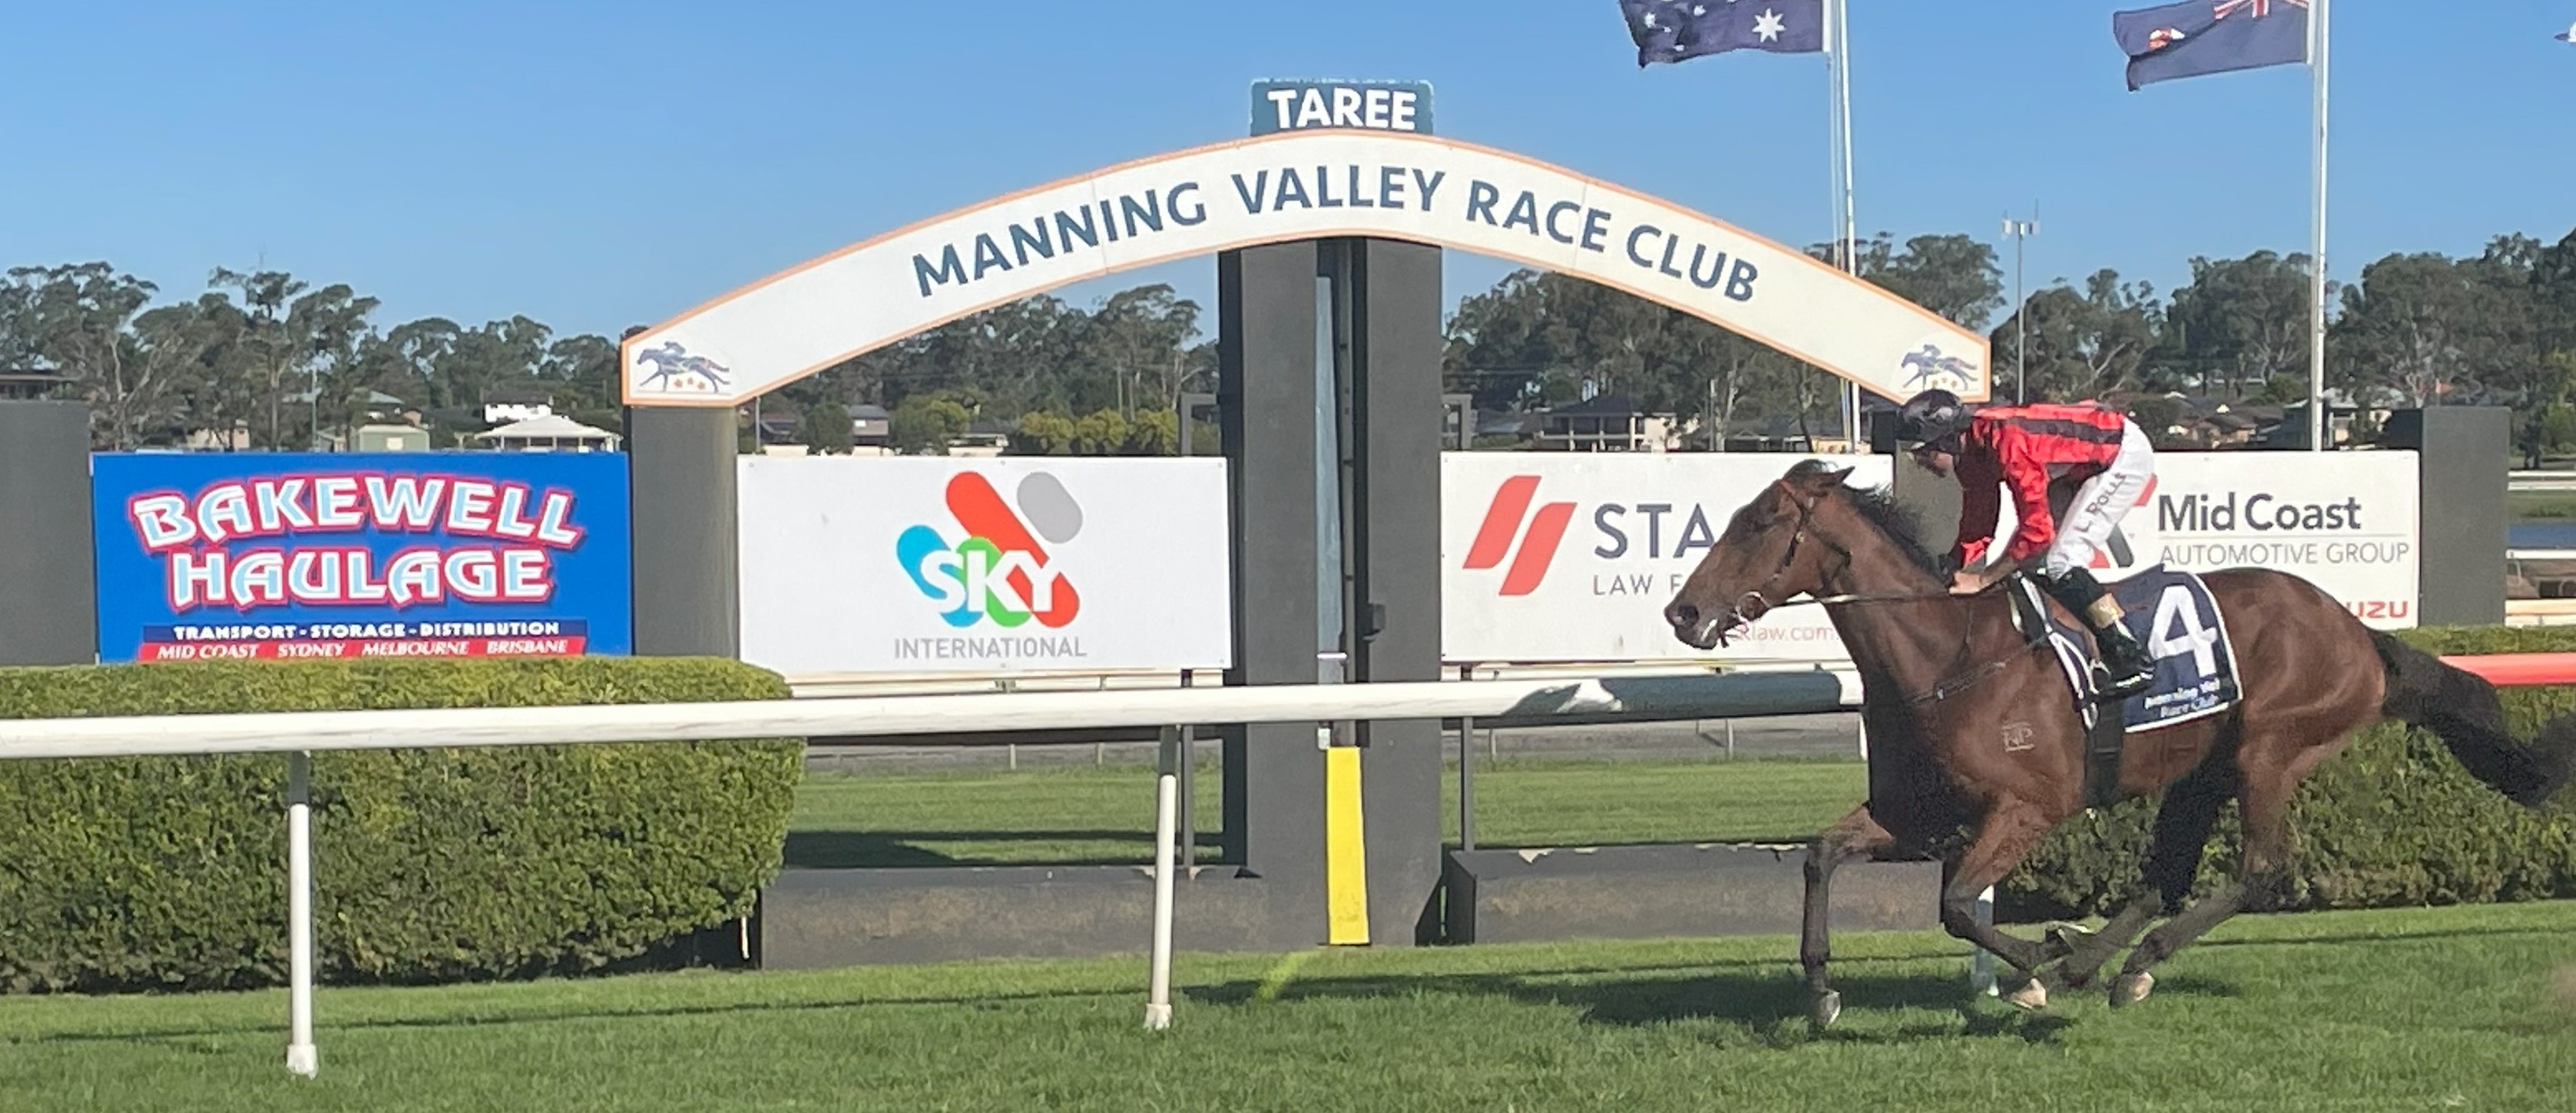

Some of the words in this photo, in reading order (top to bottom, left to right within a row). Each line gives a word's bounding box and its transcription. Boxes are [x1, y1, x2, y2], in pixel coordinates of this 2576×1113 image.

[1267, 87, 1417, 130] TAREE
[912, 182, 1206, 298] MANNING
[1231, 165, 1445, 214] VALLEY
[1466, 179, 1611, 252] RACE
[1626, 224, 1760, 302] CLUB
[130, 473, 584, 553] BAKEWELL
[1594, 502, 1715, 559] STA
[2158, 492, 2236, 531] Mid
[2244, 493, 2362, 530] Coast
[2160, 543, 2318, 566] AUTOMOTIVE
[2326, 542, 2409, 564] GROUP
[167, 546, 553, 610] HAULAGE
[919, 549, 1063, 614] SKY
[1593, 574, 1653, 596] LAW
[2346, 601, 2408, 619] UZU
[157, 645, 196, 659] MID
[199, 644, 259, 659] COAST
[277, 643, 346, 658] SYDNEY
[362, 640, 469, 656] MELBOURNE
[486, 640, 567, 654] BRISBANE
[174, 626, 295, 640] TRANSPORT
[310, 624, 405, 640] STORAGE
[420, 622, 559, 637] DISTRIBUTION
[894, 637, 1088, 659] INTERNATIONAL
[2148, 585, 2218, 679] 4
